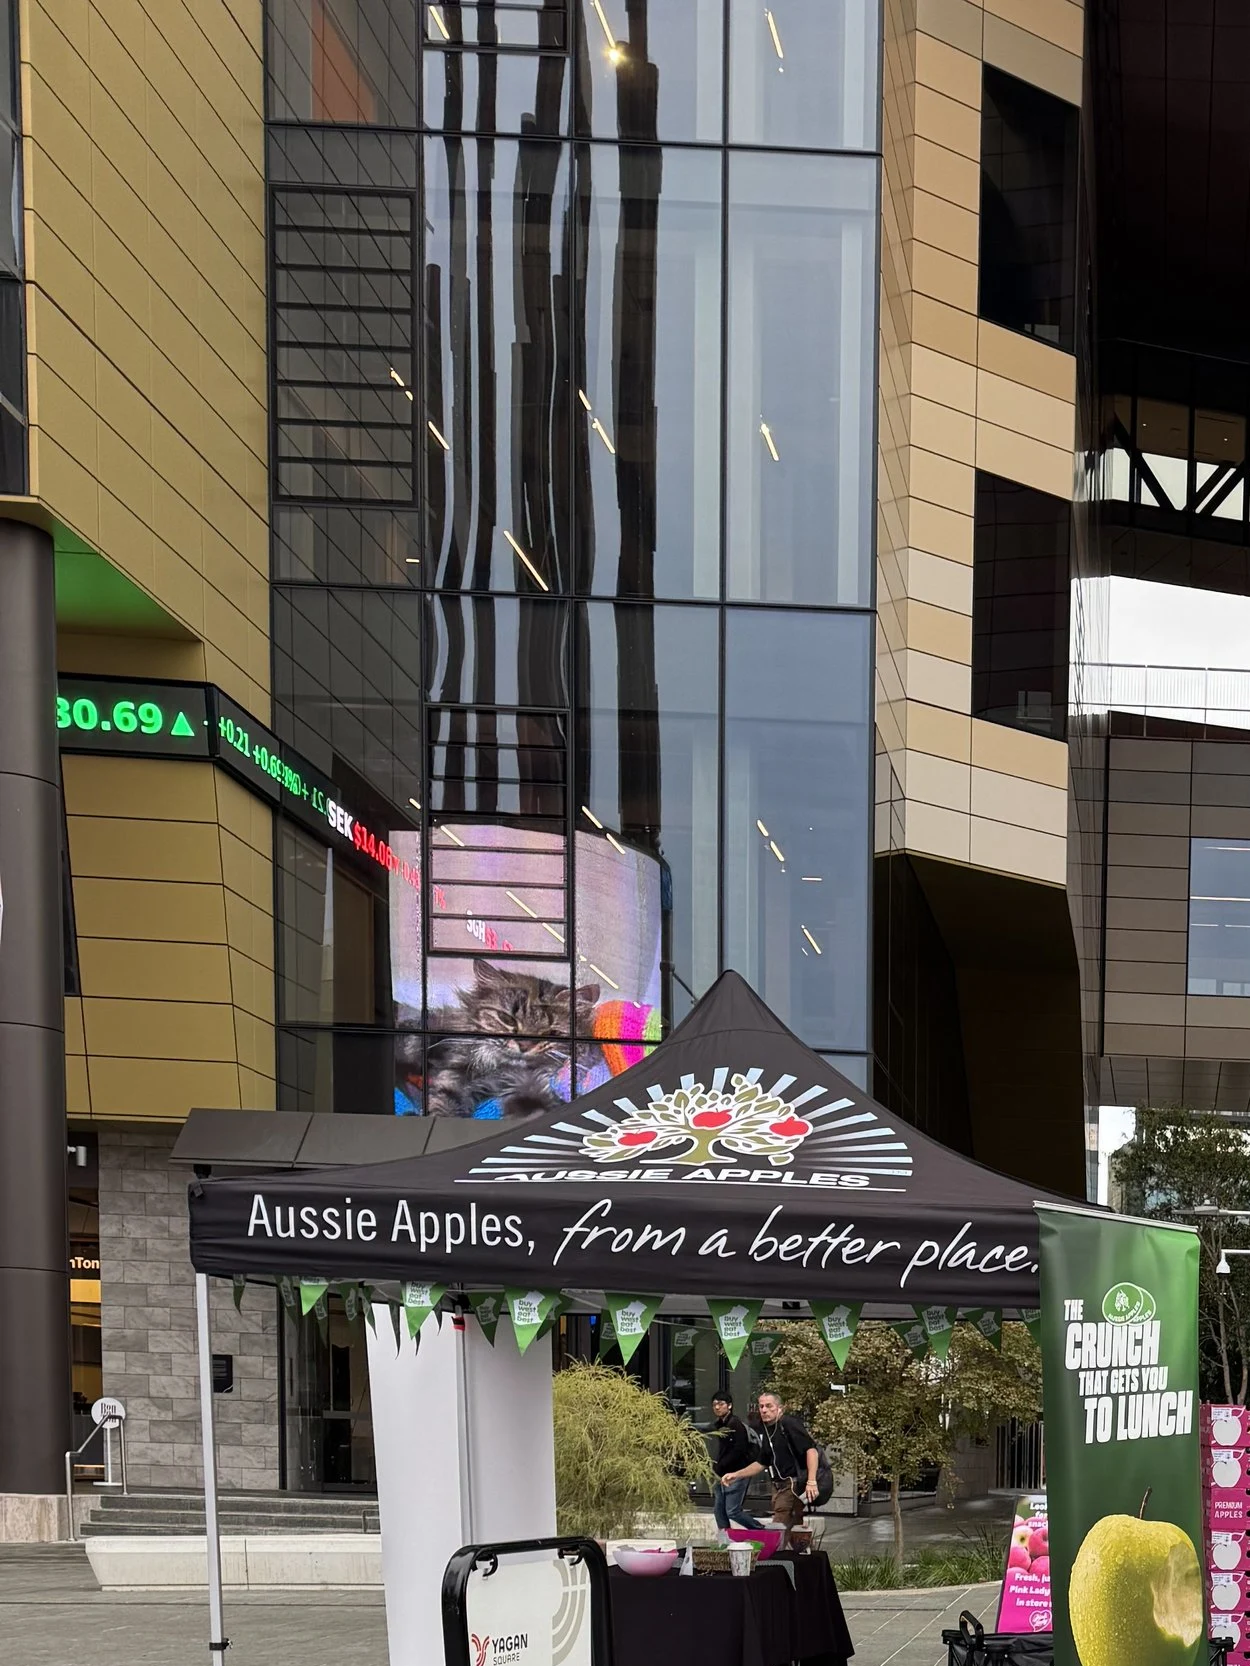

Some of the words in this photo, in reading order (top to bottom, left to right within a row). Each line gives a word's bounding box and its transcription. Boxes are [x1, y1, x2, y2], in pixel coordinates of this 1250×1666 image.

[327, 799, 354, 841] SEK
[495, 1168, 674, 1183] AUSSIE
[681, 1168, 870, 1188] APPLES
[247, 1193, 377, 1241] Aussie
[391, 1199, 536, 1256] Apples,
[553, 1199, 686, 1265] from
[699, 1228, 736, 1258] a
[748, 1205, 901, 1269] better
[899, 1221, 1039, 1288] place.
[518, 1300, 533, 1308] buy
[621, 1310, 636, 1318] buy
[1064, 1299, 1084, 1321] THE
[621, 1316, 639, 1324] west
[1065, 1320, 1161, 1370] CRUNCH
[1079, 1370, 1109, 1396] THAT
[1110, 1368, 1140, 1394] GETS
[1142, 1366, 1168, 1391] YOU
[1084, 1396, 1113, 1444] TO
[1117, 1390, 1193, 1441] LUNCH
[1015, 1573, 1040, 1582] Fresh,
[1009, 1585, 1028, 1593] Pink
[492, 1633, 528, 1654] YAGAN
[493, 1652, 520, 1666] SQUARE
